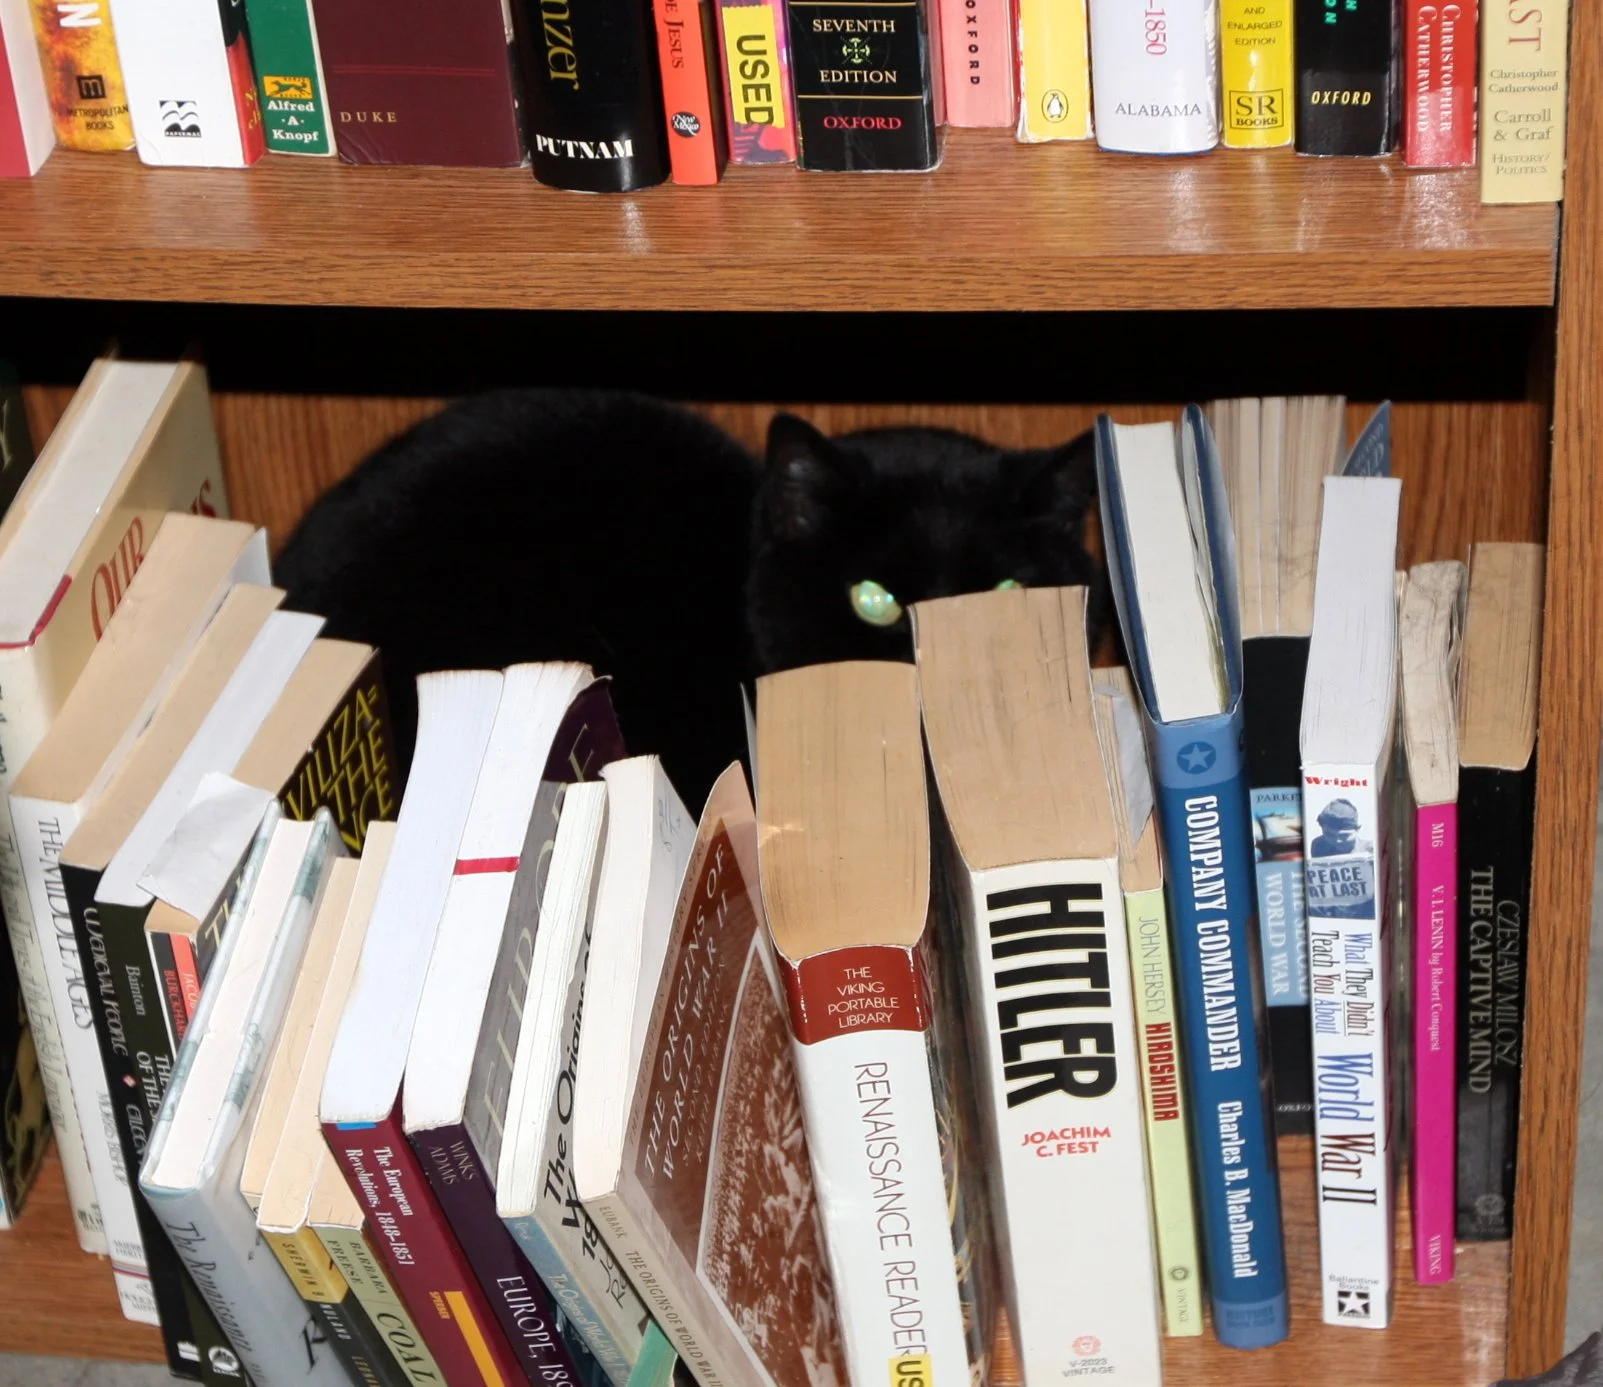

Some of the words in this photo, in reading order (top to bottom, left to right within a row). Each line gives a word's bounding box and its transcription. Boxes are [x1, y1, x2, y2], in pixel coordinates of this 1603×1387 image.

[812, 19, 896, 33] SEVENTH
[1227, 20, 1283, 31] ENLARGED
[1243, 6, 1266, 15] AND
[664, 19, 685, 69] JESUS
[965, 0, 980, 85] OXFORD
[1234, 36, 1277, 46] EDITION
[736, 34, 774, 125] USED
[820, 70, 897, 84] EDITION
[1417, 5, 1438, 133] CATHERWOOD
[1439, 4, 1461, 133] CHRISTOPHER
[1490, 68, 1559, 80] Christopher
[1235, 95, 1276, 117] SR
[1311, 90, 1372, 105] OXFORD
[1488, 82, 1559, 94] Catherwood
[67, 105, 129, 118] METROPOLITAN
[267, 100, 316, 113] Alfred
[340, 111, 397, 123] DUKE
[823, 116, 902, 130] OXFORD
[1114, 102, 1203, 118] ALABAMA
[1235, 116, 1279, 128] BOOKS
[1494, 108, 1552, 124] Carroll
[86, 120, 115, 131] BOOKS
[272, 128, 320, 144] Knopf
[1493, 130, 1506, 142] &
[1516, 126, 1555, 141] Graf
[536, 133, 635, 160] PUTNAM
[1495, 163, 1548, 175] POLITICS
[1305, 776, 1368, 788] Wright
[1184, 795, 1228, 911] COMPANY
[1307, 866, 1363, 884] PEACE
[1308, 884, 1326, 898] AT
[1331, 881, 1368, 897] LAST
[1431, 884, 1444, 898] V.
[1471, 866, 1494, 917] THE
[38, 816, 64, 857] THE
[62, 962, 94, 1030] AGES
[1264, 872, 1286, 946] WORLD
[1139, 917, 1160, 957] JOHN
[1431, 910, 1444, 950] LENIN
[1311, 930, 1341, 968] Teach
[1344, 932, 1373, 965] What
[1428, 952, 1444, 966] by
[125, 964, 147, 1016] Bainton
[837, 981, 885, 996] VIKING
[844, 966, 872, 980] THE
[1143, 961, 1167, 1016] HERSEY
[1269, 953, 1291, 997] WAR
[1313, 973, 1341, 995] You
[1342, 967, 1374, 998] They
[1431, 966, 1444, 1000] Robert
[1470, 920, 1493, 1024] CAPTIVE
[645, 1090, 666, 1177] THE
[662, 904, 705, 1082] ORIGINS
[706, 843, 724, 899] OF
[828, 997, 900, 1015] PORTABLE
[986, 882, 1118, 1109] HITLER
[1196, 918, 1242, 1072] COMMANDER
[103, 998, 129, 1058] PEOPLE
[663, 1033, 693, 1180] WORLD
[692, 936, 718, 1020] WAR
[716, 889, 729, 930] II
[838, 1012, 893, 1029] LIBRARY
[1314, 998, 1342, 1035] About
[1346, 1001, 1375, 1037] Didn't
[1427, 1003, 1444, 1052] Conquest
[135, 1050, 152, 1072] OF
[1145, 1021, 1180, 1122] HIROSHIMA
[1469, 1026, 1492, 1093] MIND
[142, 1073, 160, 1109] THE
[696, 1093, 710, 1163] KEITH
[707, 1003, 729, 1087] EUBANK
[1317, 1052, 1375, 1122] World
[683, 1064, 701, 1167] SECOND
[1217, 1100, 1242, 1166] Charles
[1021, 1126, 1112, 1146] JOACHIM
[1035, 1144, 1054, 1158] C.
[1056, 1141, 1100, 1154] FEST
[428, 1147, 460, 1185] ADAMS
[450, 1140, 480, 1181] WINKS
[544, 1132, 569, 1205] The
[854, 1062, 912, 1251] RENAISSANCE
[1321, 1132, 1376, 1179] War
[373, 1147, 392, 1168] The
[383, 1168, 413, 1217] European
[1224, 1167, 1249, 1187] B.
[1322, 1185, 1377, 1205] II
[345, 1148, 380, 1209] Revolutions,
[375, 1210, 416, 1266] 1848-1851
[167, 1222, 206, 1253] The
[1226, 1188, 1259, 1279] MacDonald
[327, 1240, 364, 1284] FREESE
[349, 1241, 388, 1294] BARBARA
[1428, 1234, 1442, 1276] VIKING
[282, 1243, 317, 1286] SHERWIN
[319, 1303, 352, 1340] NULAND
[548, 1273, 569, 1288] The
[599, 1205, 629, 1240] EUBANK
[625, 1250, 647, 1270] THE
[640, 1272, 674, 1312] ORIGINS
[665, 1312, 683, 1325] OF
[674, 1326, 704, 1359] WORLD
[696, 1360, 716, 1379] WAR
[1328, 1273, 1379, 1285] Ballantine
[1339, 1282, 1369, 1290] Books
[185, 1256, 253, 1352] Renaissance
[429, 1290, 452, 1320] SPERBER
[496, 1275, 557, 1359] EUROPE,
[1176, 1287, 1189, 1323] VINTAGE
[377, 1312, 437, 1383] COAL
[1069, 1358, 1109, 1367] V-2023
[1062, 1366, 1115, 1377] VINTAGE
